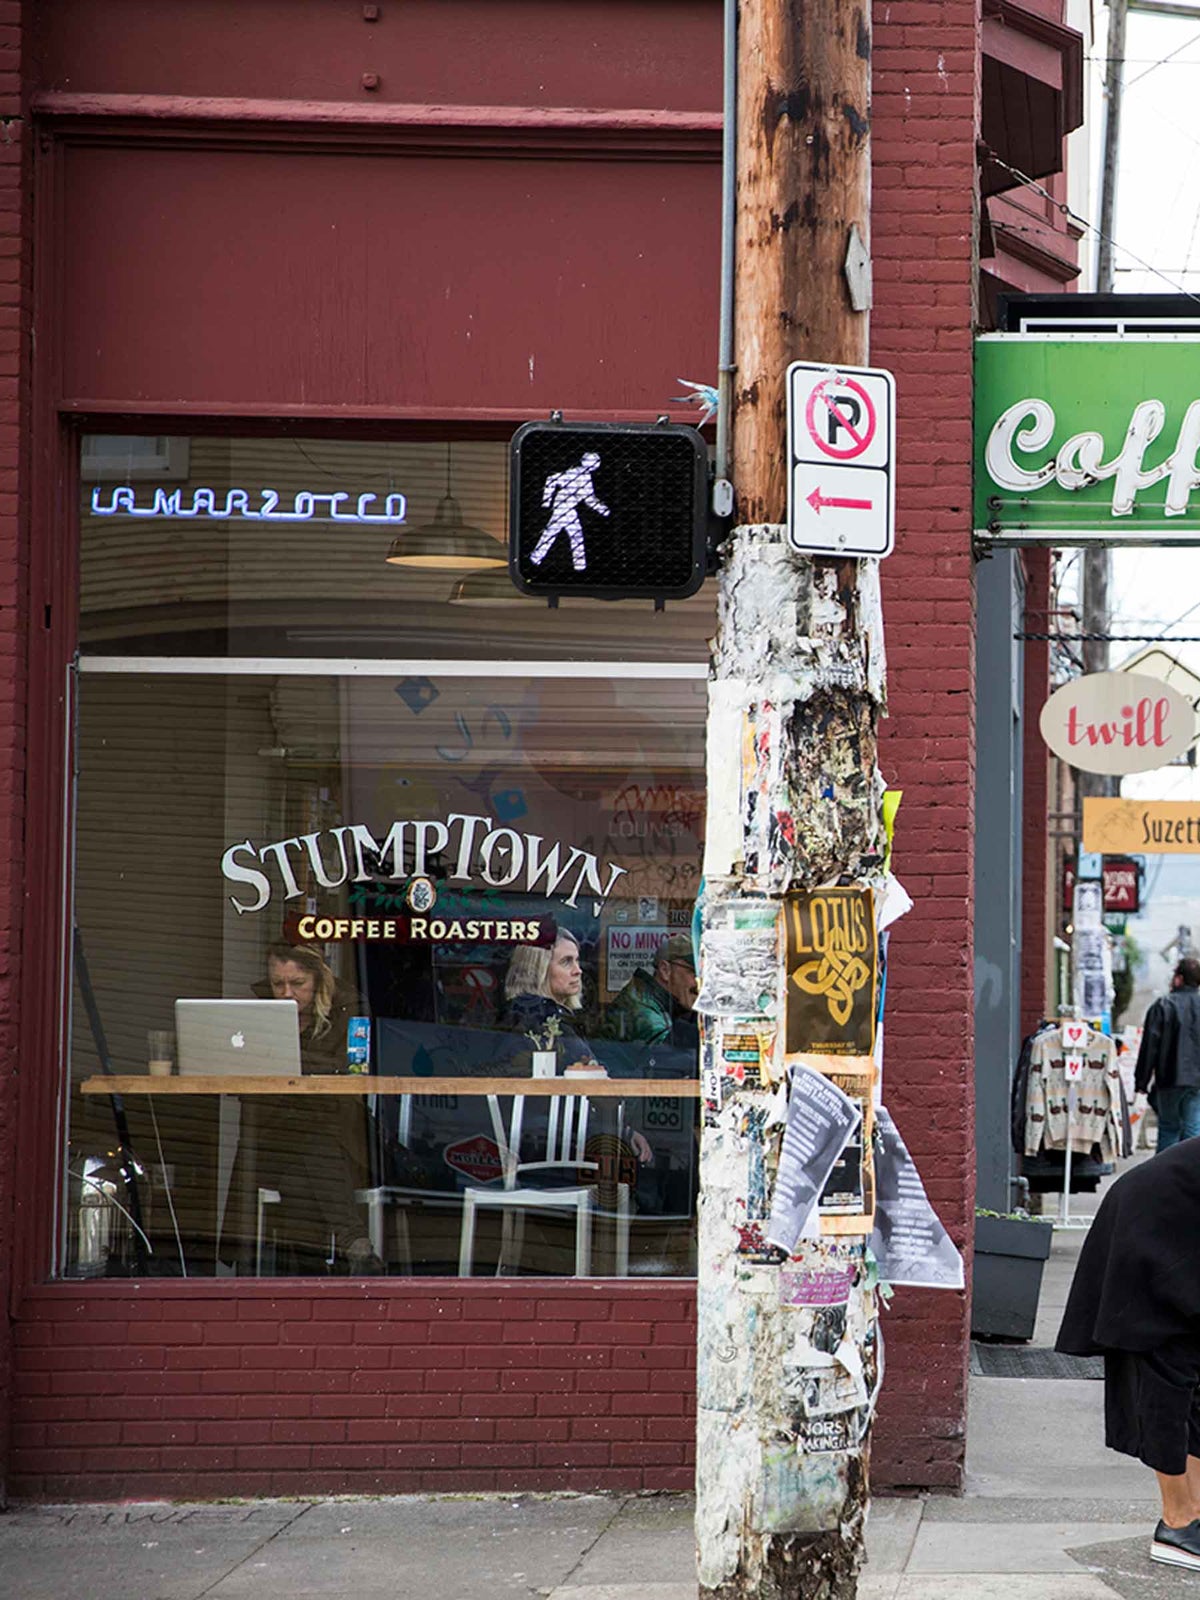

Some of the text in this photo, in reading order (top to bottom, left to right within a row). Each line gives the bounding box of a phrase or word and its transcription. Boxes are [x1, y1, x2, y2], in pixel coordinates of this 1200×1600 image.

[1063, 697, 1172, 749] twill
[221, 812, 628, 918] STUMPTOWN
[298, 915, 541, 941] COFFEE ROASTERS
[611, 932, 631, 949] NO
[792, 894, 866, 953] LOTUS
